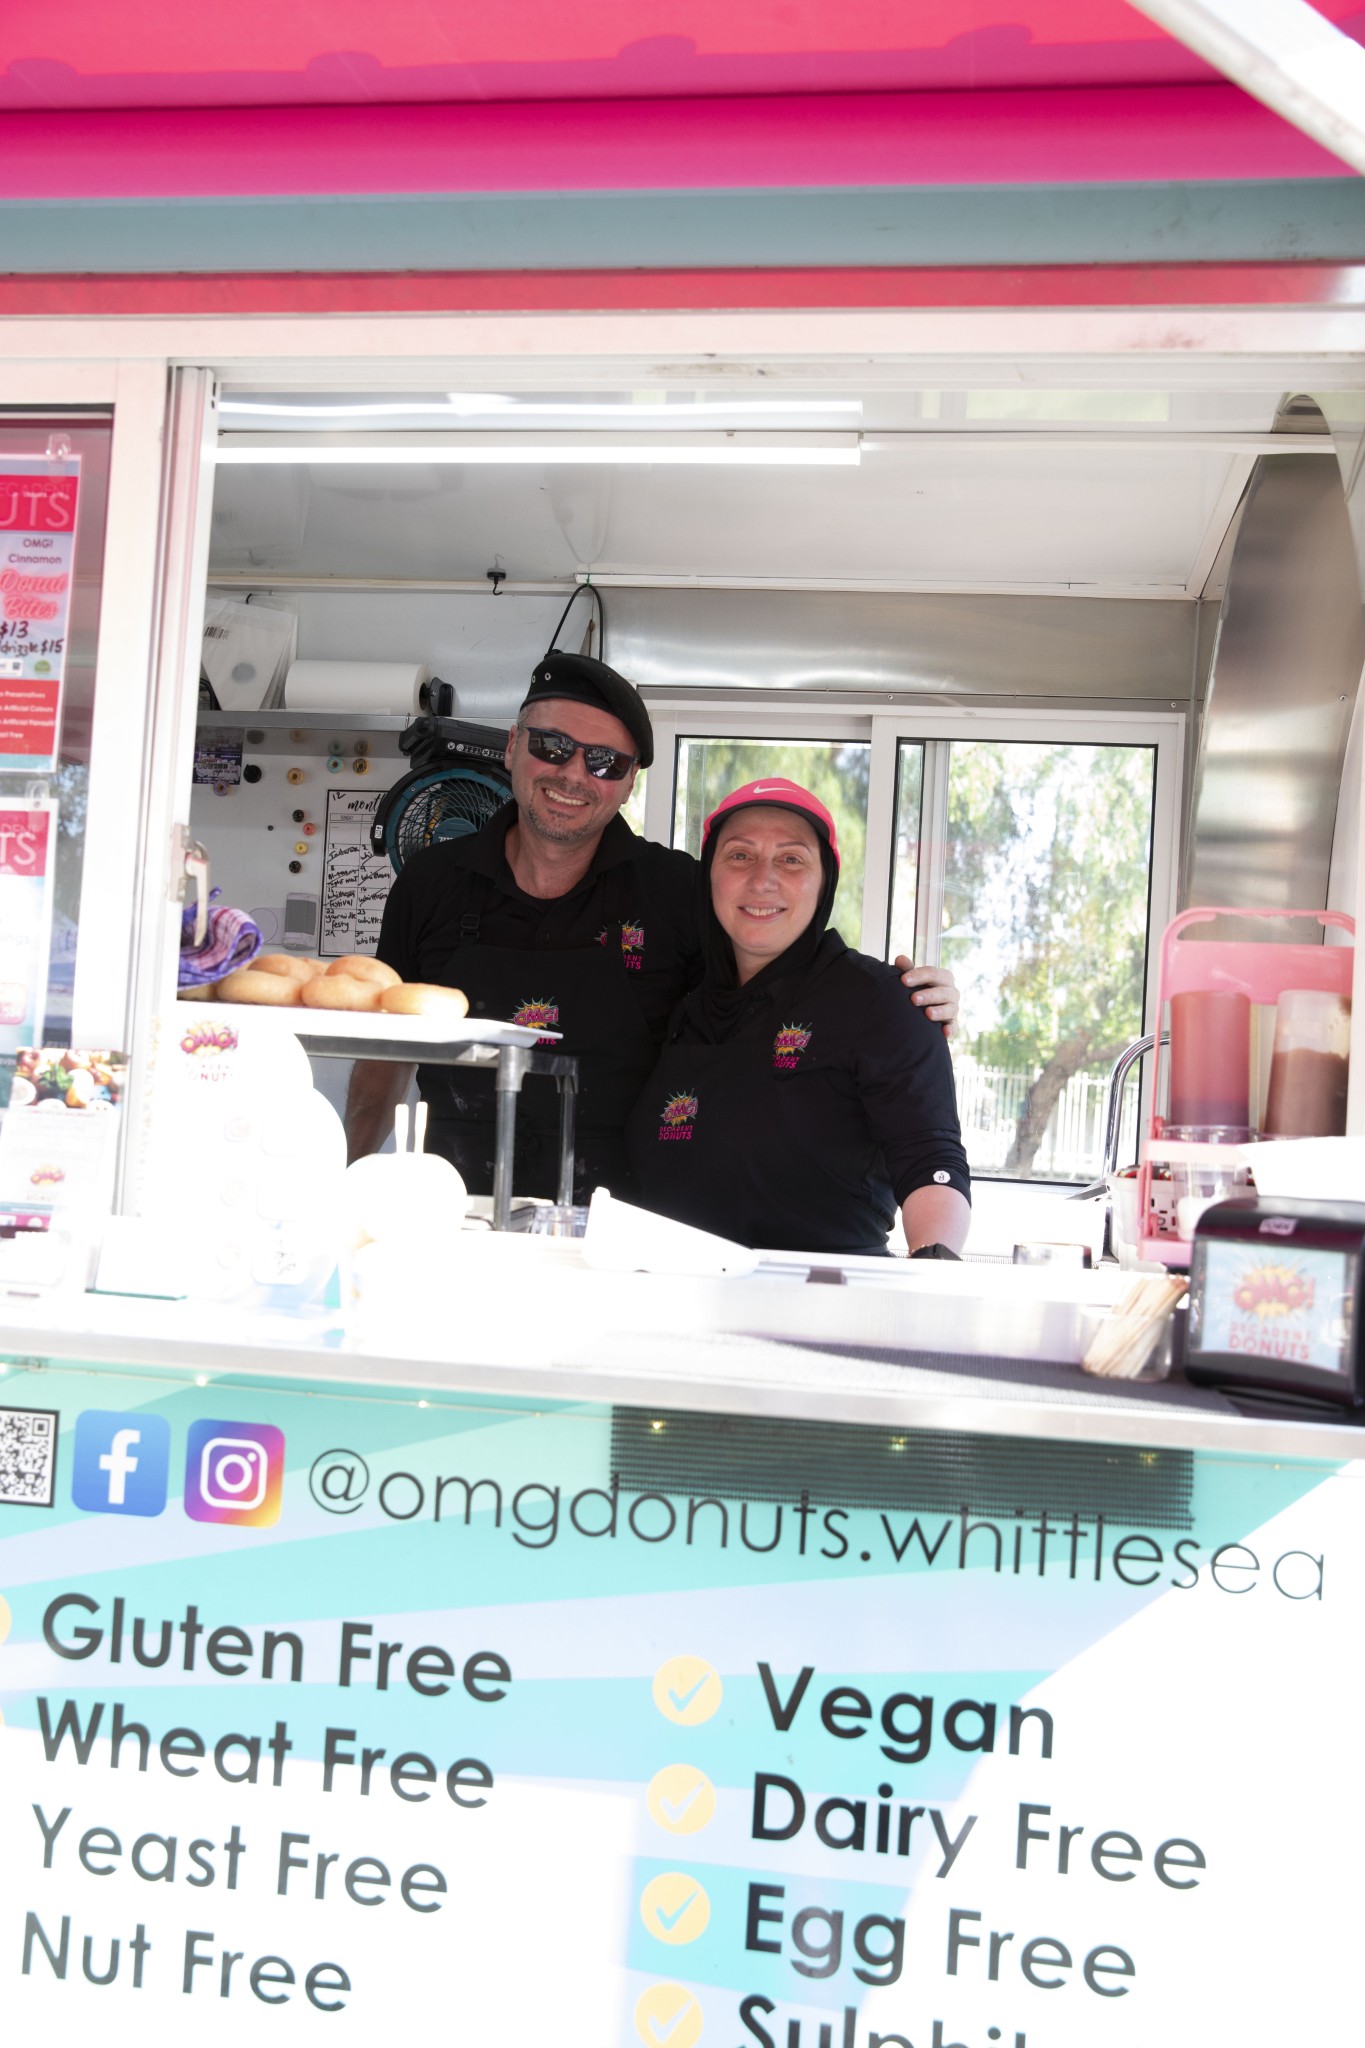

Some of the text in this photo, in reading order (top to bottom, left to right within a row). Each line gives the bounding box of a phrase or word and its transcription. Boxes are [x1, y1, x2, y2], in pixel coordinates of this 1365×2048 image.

[8, 553, 62, 564] Cinnamon
[22, 538, 54, 549] OMG!
[4, 596, 57, 619] Bites
[41, 638, 64, 656] $15
[513, 1007, 559, 1026] OMG!
[658, 1132, 692, 1141] DONUTS
[663, 1099, 699, 1122] OMG!
[1227, 1333, 1310, 1361] DONUTS
[308, 1447, 1325, 1601] @omgdonuts.whittlesea
[42, 1592, 513, 1703] Gluten Free
[756, 1660, 1055, 1765] Vegan
[35, 1695, 495, 1809] Wheat Free
[31, 1802, 448, 1913] Yeast Free
[750, 1770, 1208, 1891] Dairy Free
[20, 1910, 352, 2012] Nut Free
[744, 1882, 1137, 1999] Egg Free
